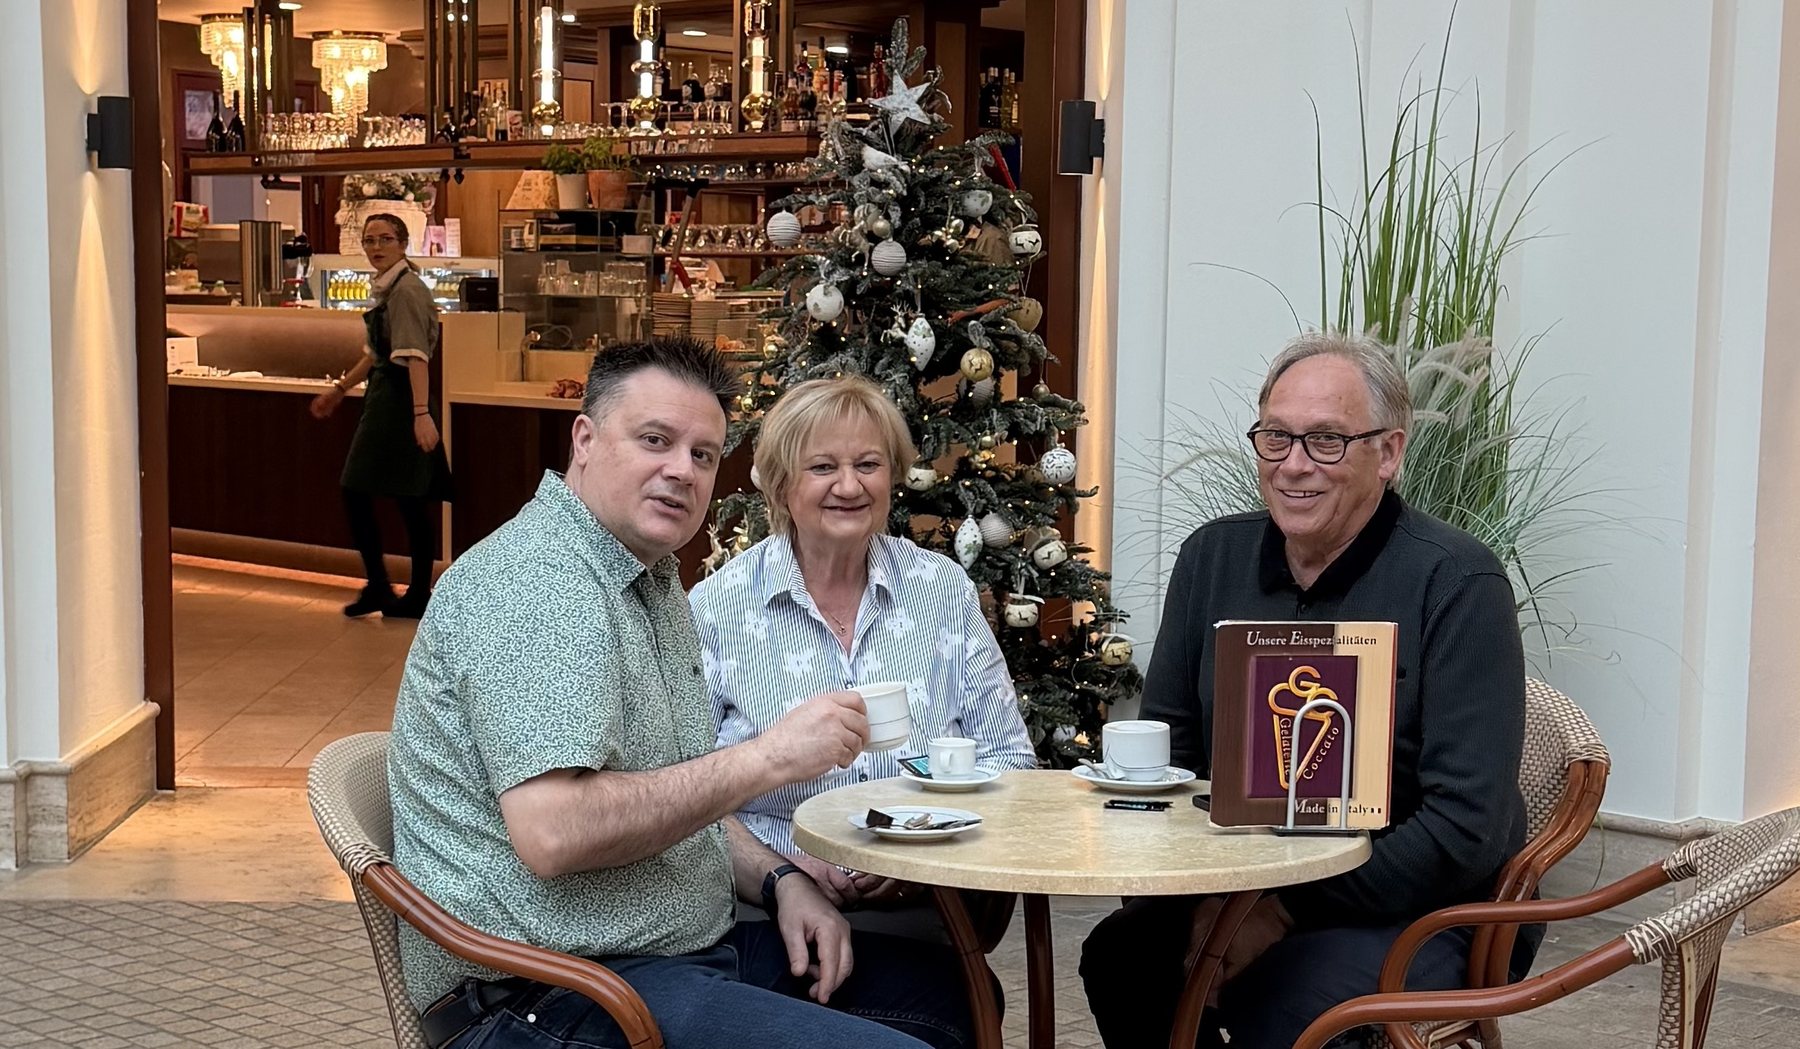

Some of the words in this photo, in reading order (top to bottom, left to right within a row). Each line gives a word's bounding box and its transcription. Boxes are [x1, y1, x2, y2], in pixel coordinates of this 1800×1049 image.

[1246, 631, 1287, 646] Unsere
[1303, 727, 1339, 780] Coccato
[1328, 803, 1338, 813] in
[1347, 804, 1368, 816] taly
